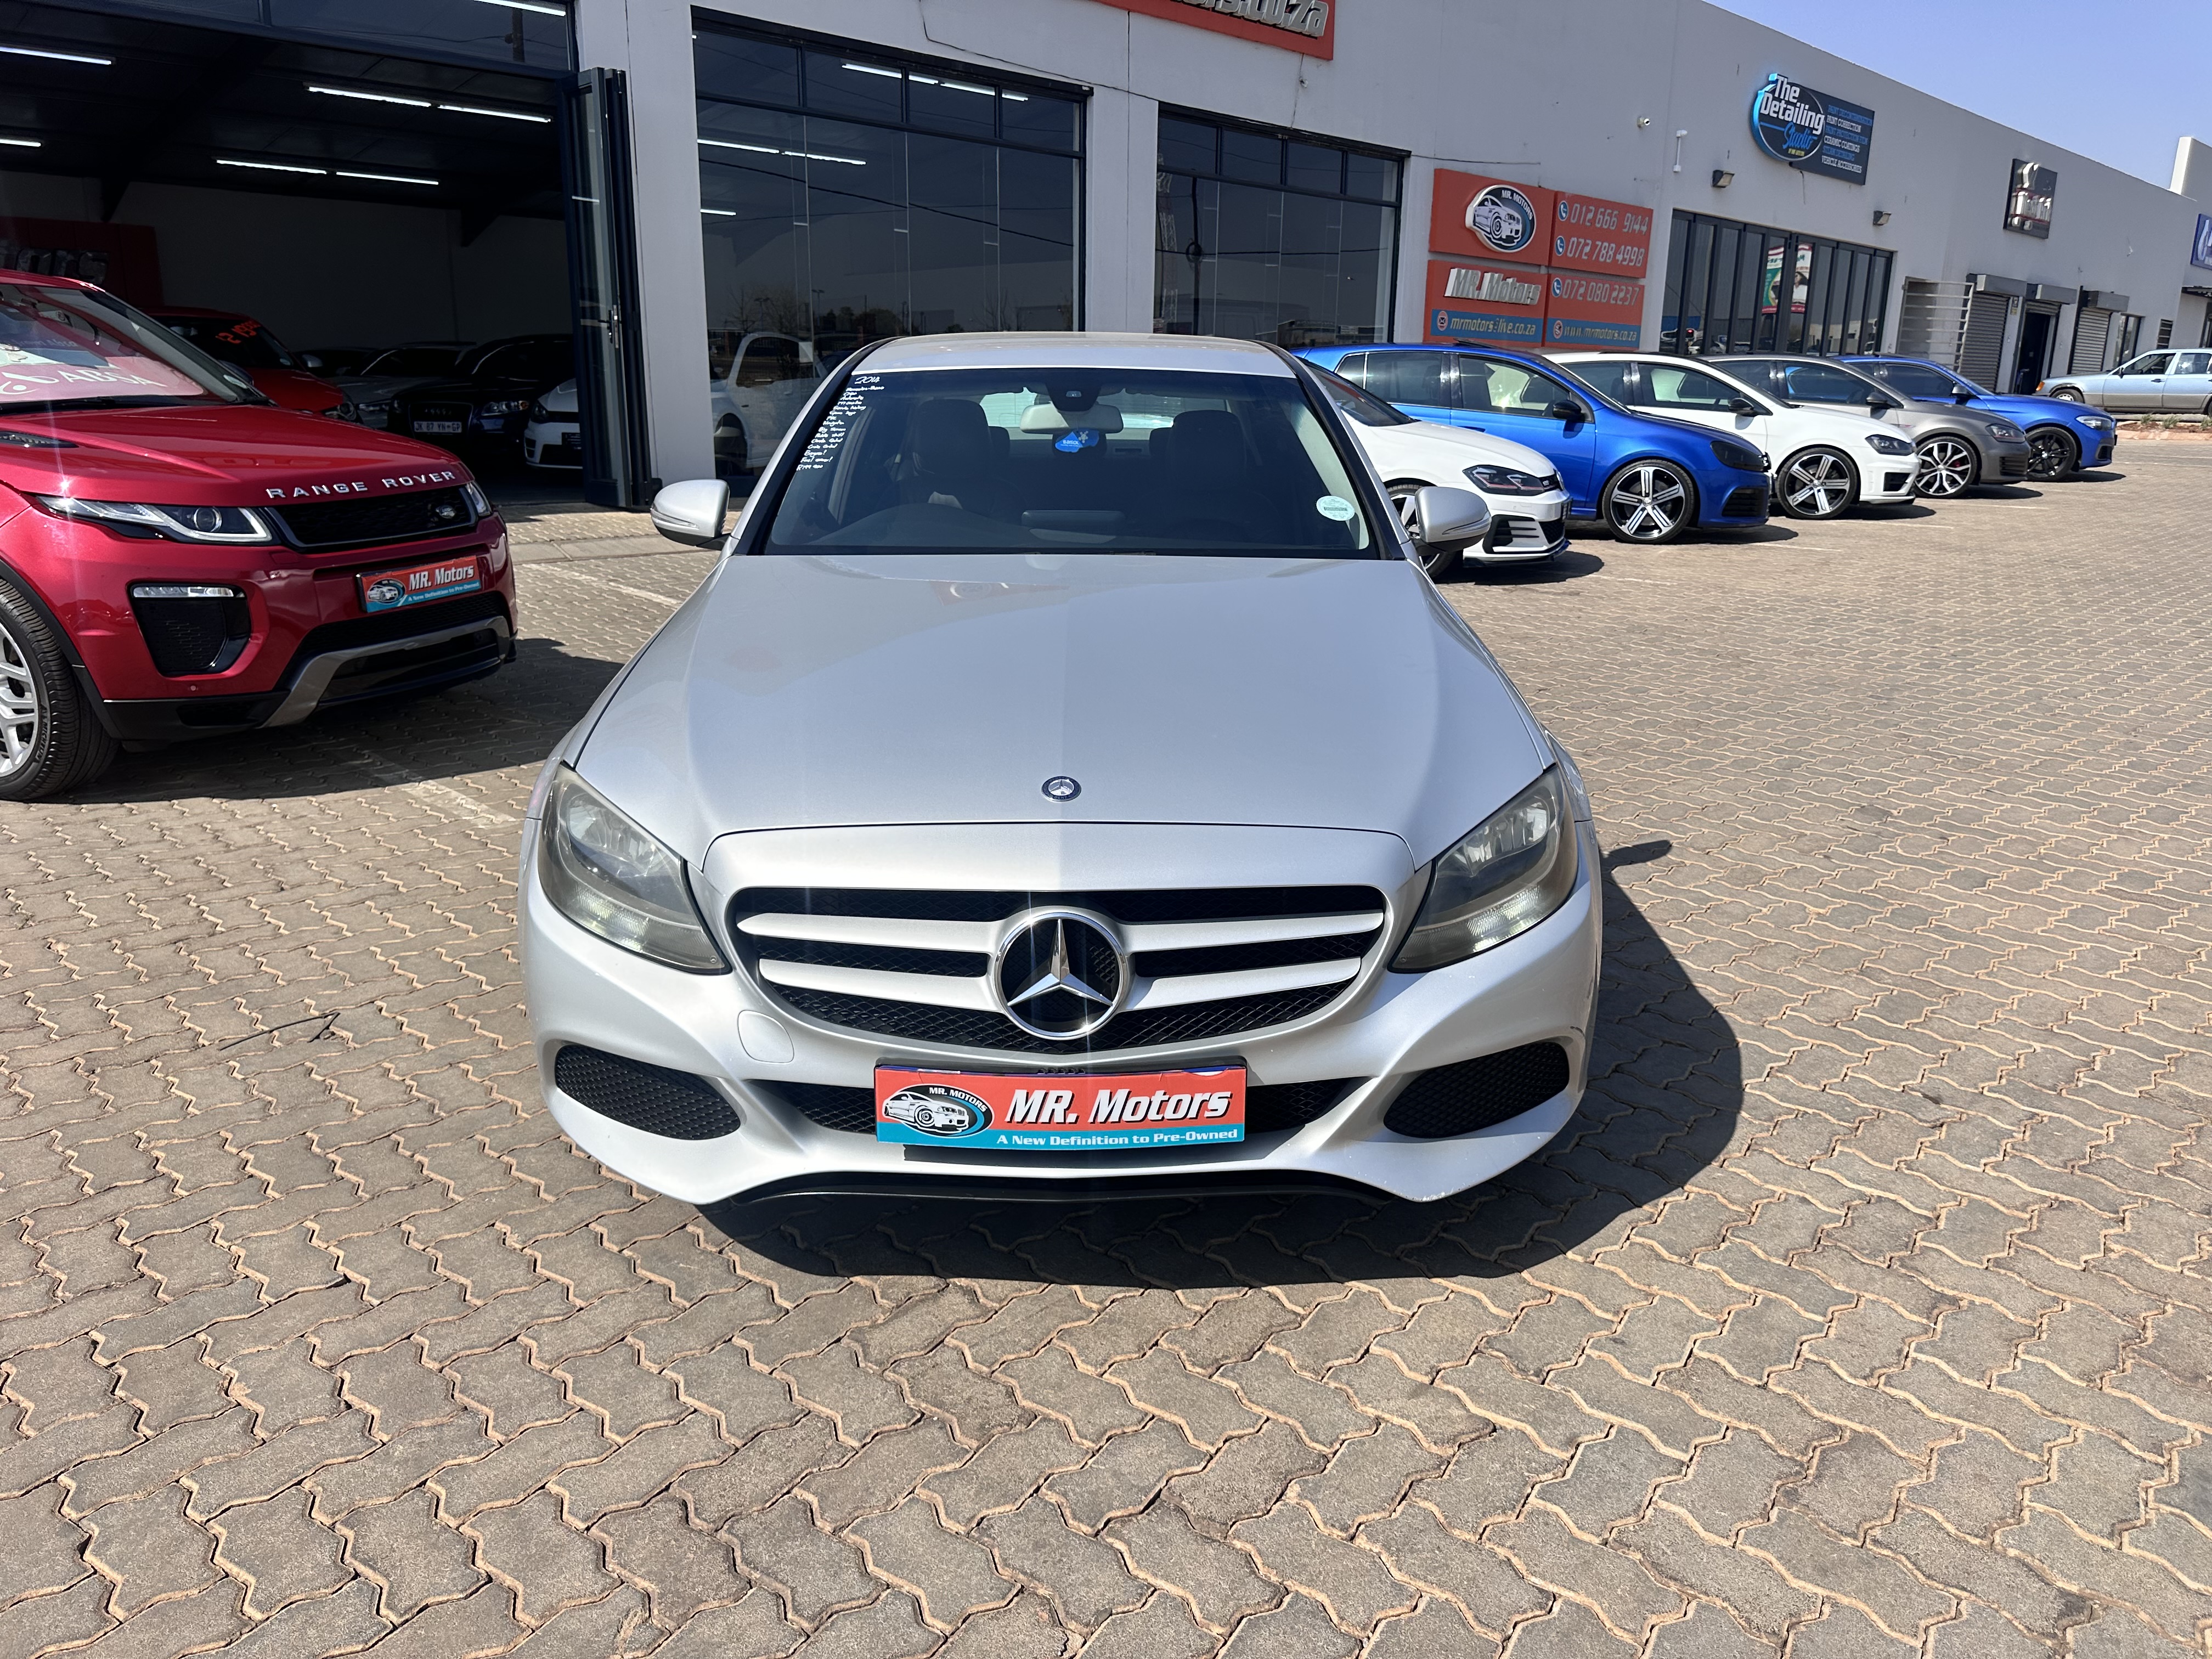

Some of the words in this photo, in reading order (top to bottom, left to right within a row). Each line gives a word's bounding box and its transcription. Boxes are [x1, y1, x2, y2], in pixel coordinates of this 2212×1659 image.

[1775, 75, 1800, 103] The
[1760, 92, 1825, 135] Detailing
[1782, 122, 1818, 150] Studio
[1513, 193, 1533, 220] MOTORS
[1570, 203, 1595, 226] 012
[1595, 207, 1618, 230] 666
[1622, 212, 1649, 235] 9144
[1567, 236, 1592, 259] 072
[1593, 241, 1616, 263] 788
[1616, 245, 1645, 267] 4998
[1446, 268, 1481, 299] MR.
[1480, 272, 1541, 305] Motors
[1563, 279, 1587, 300] 072
[1587, 281, 1610, 303] 080
[1610, 284, 1640, 306] 2237
[1564, 326, 1637, 341] www.mrmotors.co.za
[57, 368, 167, 387] ABSA
[854, 376, 881, 385] 2014
[266, 481, 368, 499] RANGE
[382, 470, 456, 488] ROVER
[409, 571, 432, 591] MR.
[434, 565, 474, 586] Motors
[929, 1087, 947, 1096] MR.
[950, 1088, 988, 1112] MOTORS
[1005, 1088, 1078, 1123] MR.
[1087, 1088, 1233, 1123] Motors
[997, 1135, 1008, 1144] A
[1012, 1135, 1046, 1145] New
[1050, 1135, 1129, 1146] Definition
[1132, 1135, 1149, 1144] to
[1154, 1129, 1238, 1143] Pre-Owned
